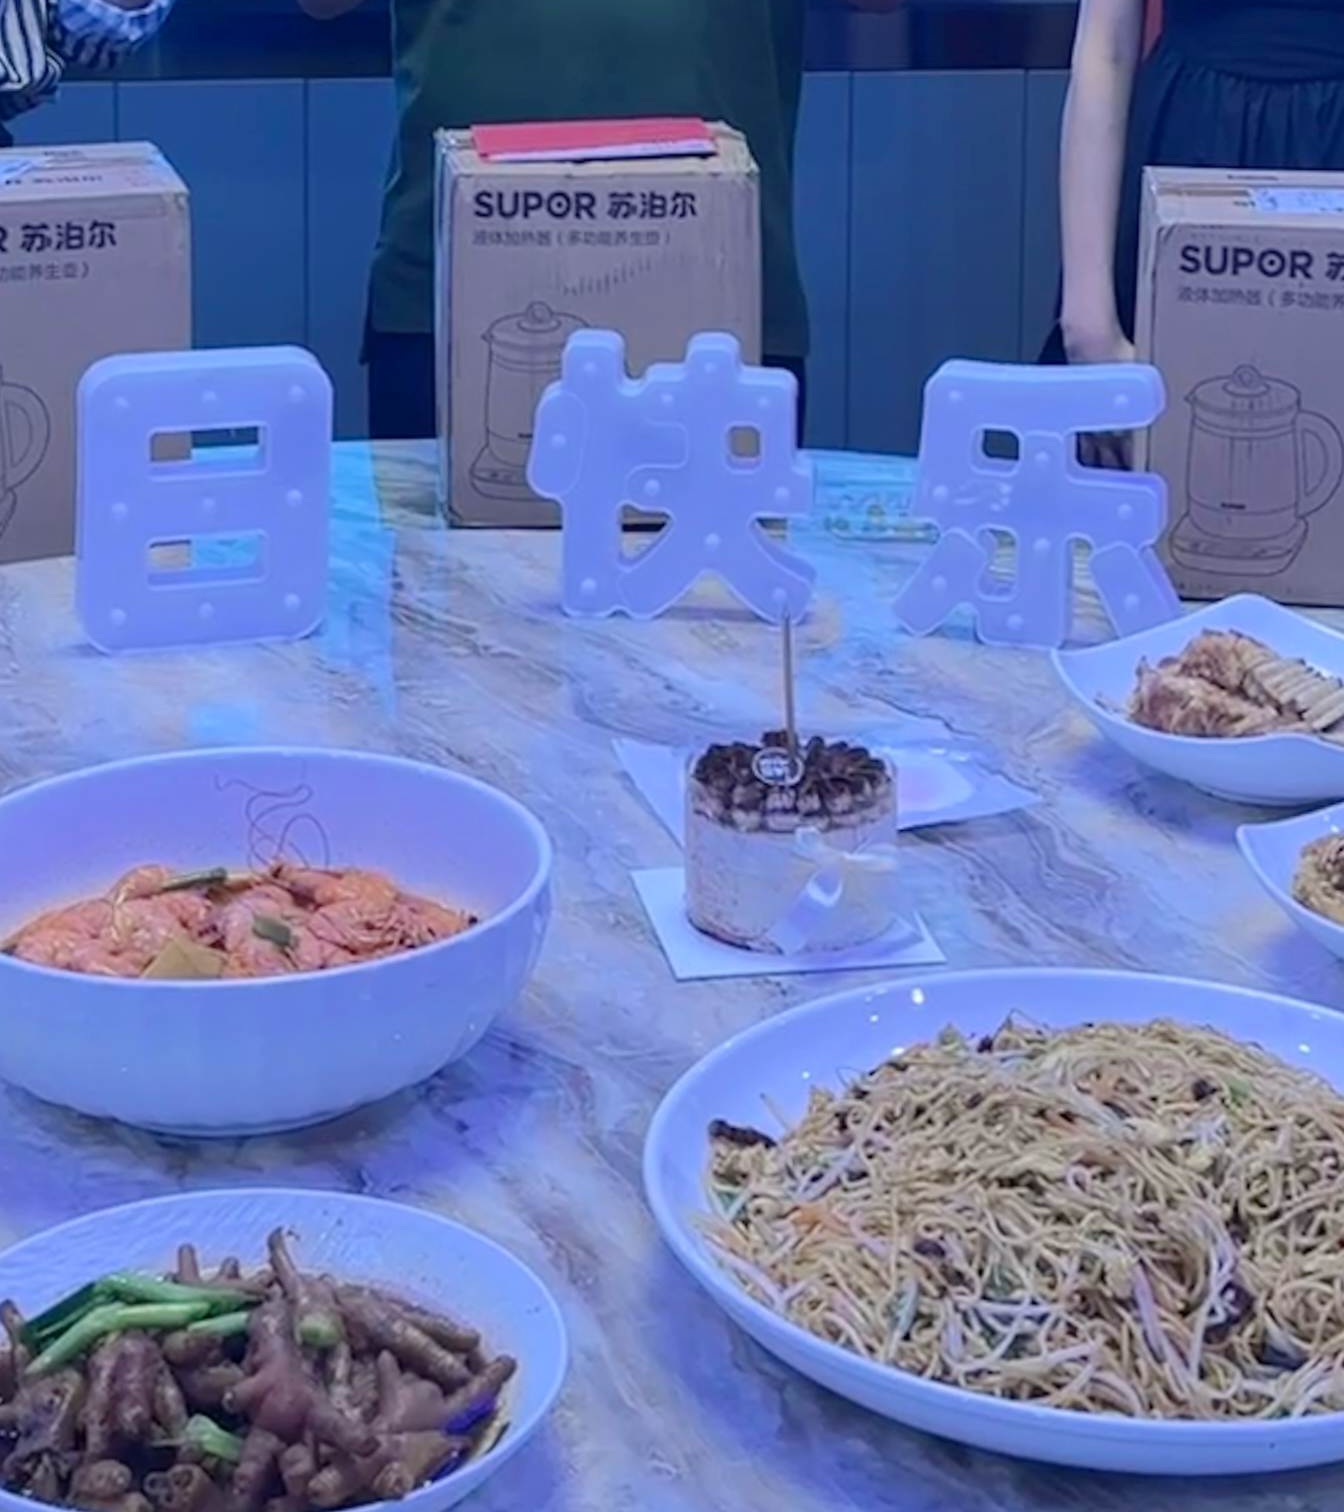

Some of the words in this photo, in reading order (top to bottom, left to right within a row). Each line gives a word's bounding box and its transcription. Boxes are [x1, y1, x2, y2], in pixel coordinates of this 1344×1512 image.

[473, 190, 597, 220] SUPOR
[606, 190, 698, 219] 苏泊尔
[19, 219, 118, 254] 苏泊尔
[1178, 244, 1315, 280] SUPOR
